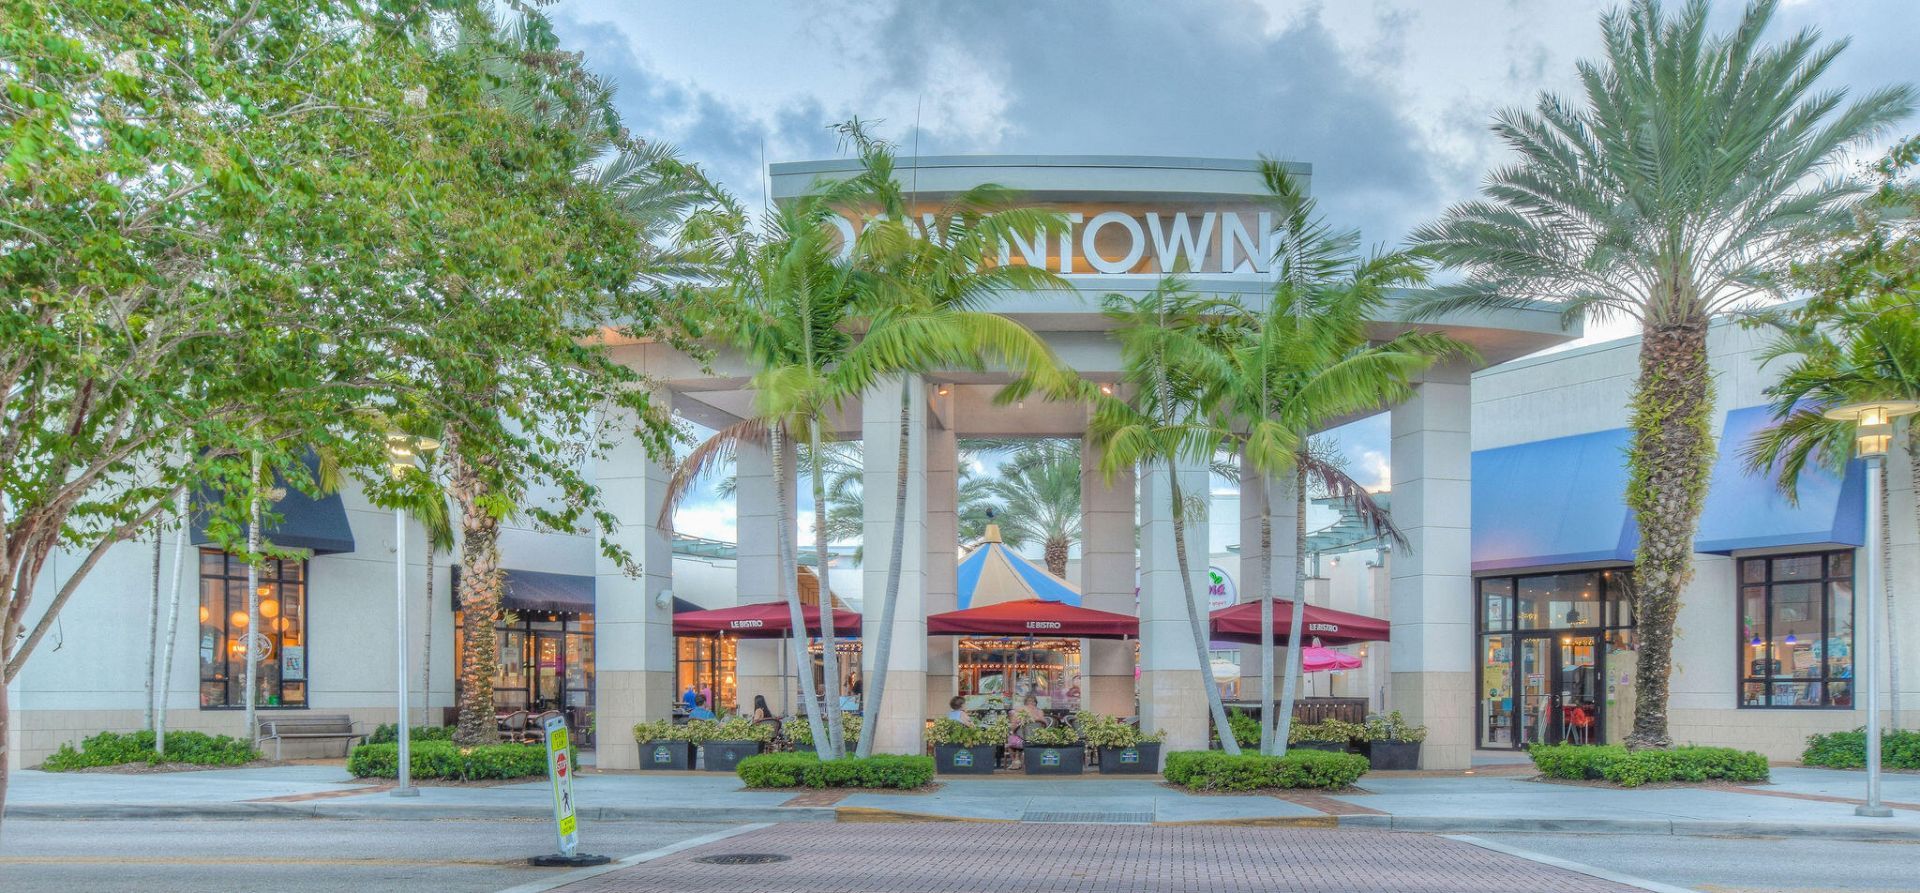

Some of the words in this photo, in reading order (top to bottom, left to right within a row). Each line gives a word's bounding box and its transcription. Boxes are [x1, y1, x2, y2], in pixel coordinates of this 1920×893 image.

[731, 620, 739, 628] LE
[740, 619, 763, 627] BISTRO
[1036, 621, 1061, 629] BISTRO
